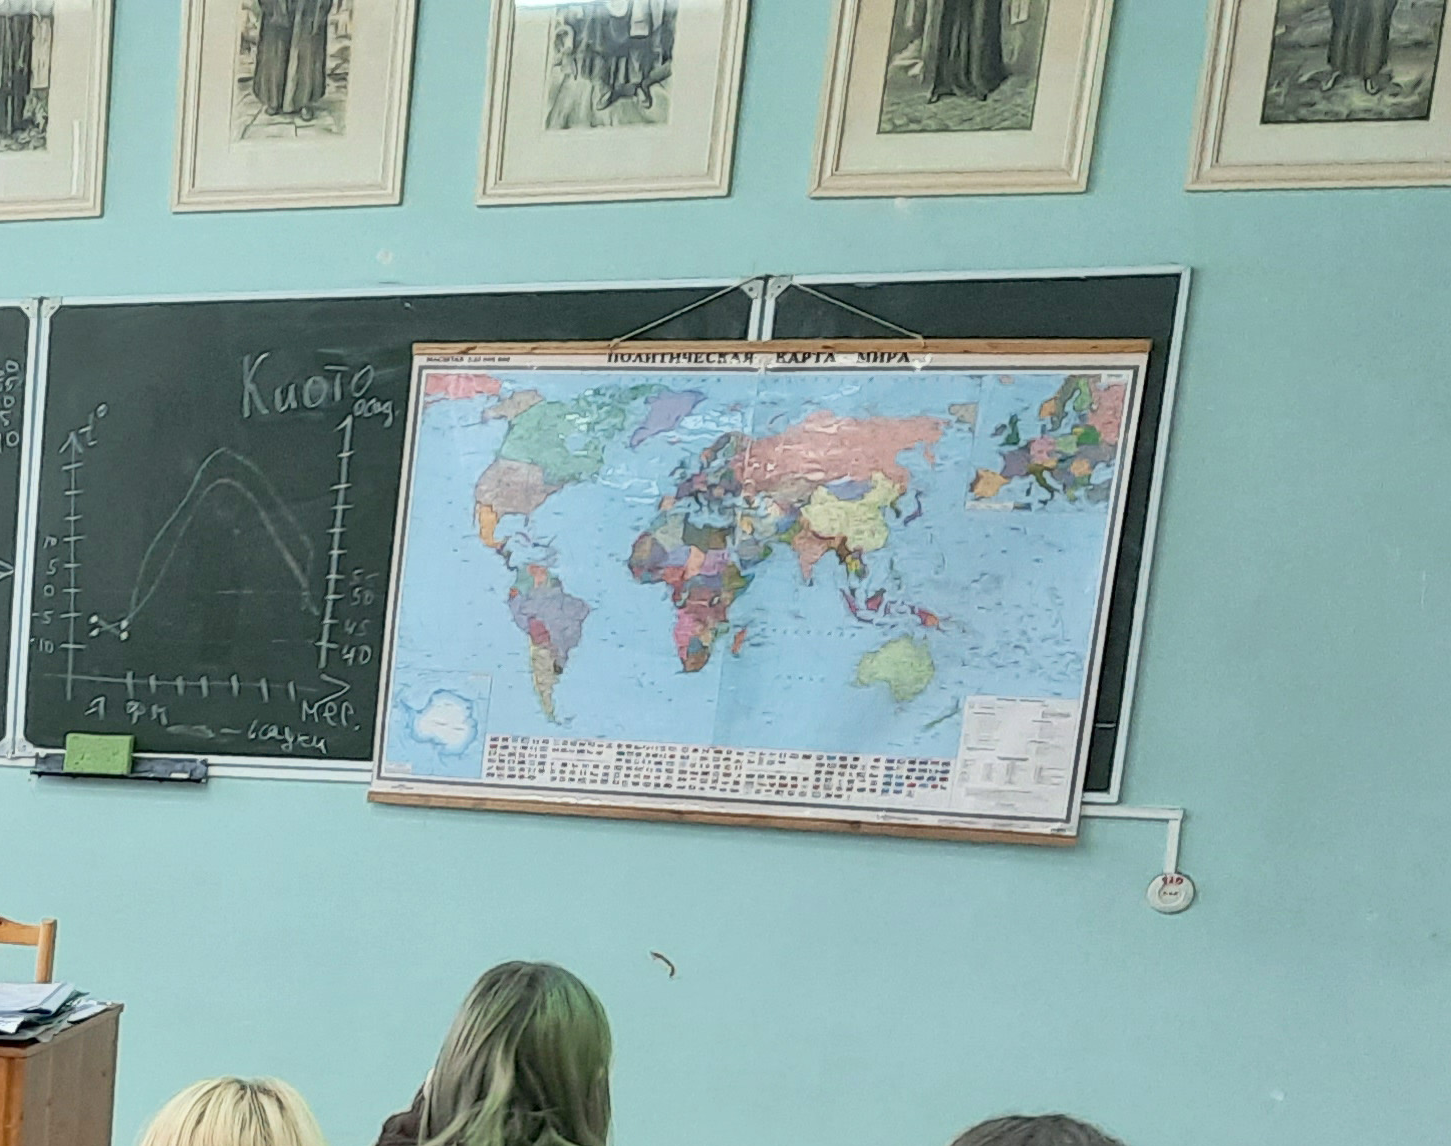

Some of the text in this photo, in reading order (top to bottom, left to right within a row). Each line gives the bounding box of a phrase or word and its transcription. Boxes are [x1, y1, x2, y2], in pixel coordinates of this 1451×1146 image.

[606, 351, 910, 364] ПОЛИТИЧЕСКАЯ КАРТА МИРА
[46, 558, 59, 575] 5
[43, 584, 55, 597] 0
[342, 644, 372, 667] 40
